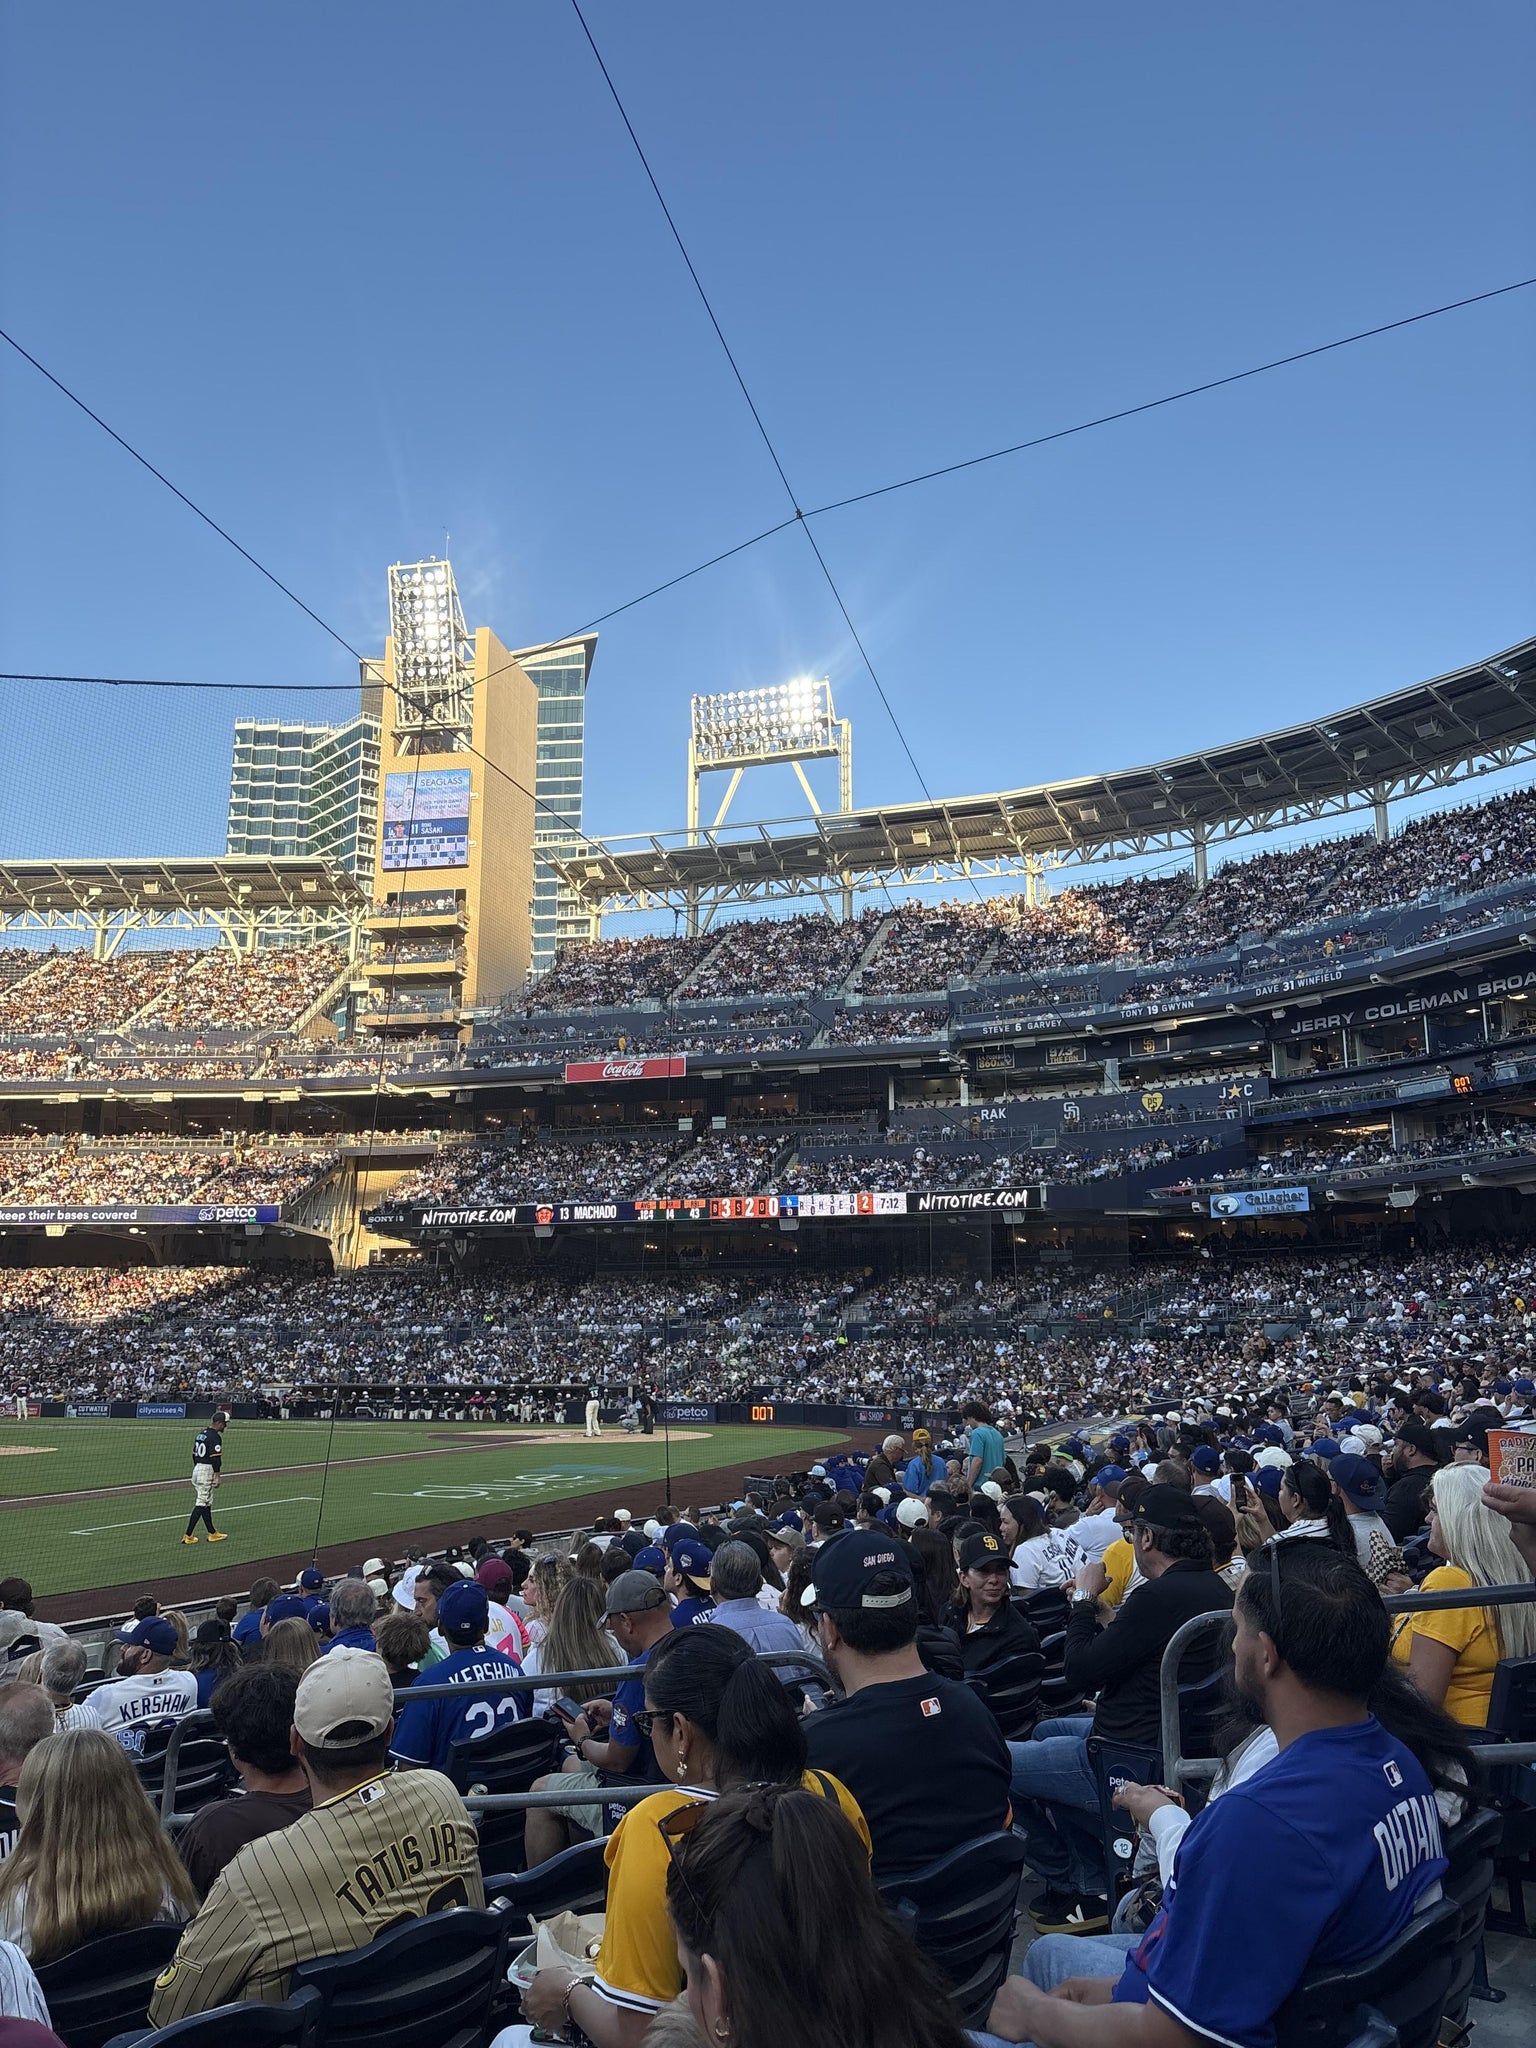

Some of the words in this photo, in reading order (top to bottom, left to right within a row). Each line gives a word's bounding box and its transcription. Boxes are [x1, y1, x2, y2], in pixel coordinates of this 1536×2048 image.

[420, 777, 463, 787] SEAGLASS
[1255, 984, 1280, 997] DAVE
[1282, 980, 1295, 992] 31
[1296, 971, 1343, 988] WINFIELD
[1120, 1007, 1144, 1019] TONY
[1147, 1004, 1159, 1016] 19
[1161, 999, 1195, 1012] GWYNN
[1290, 1011, 1355, 1034] JERRY
[1364, 987, 1469, 1020] COLEMAN
[982, 1025, 1010, 1035] STEVE
[1015, 1022, 1022, 1032] 6
[1027, 1019, 1062, 1030] GARVEY
[1243, 1083, 1253, 1096] C
[1147, 1097, 1158, 1109] PS
[980, 1107, 1007, 1120] RAK
[830, 1194, 835, 1204] 3
[849, 1194, 855, 1204] 0
[861, 1195, 870, 1209] 2
[880, 1197, 899, 1209] 7:12
[918, 1189, 1028, 1211] NITTOTIRE.COM
[1245, 1190, 1305, 1206] Gallagher
[721, 1198, 731, 1218] 3
[745, 1197, 755, 1218] 2
[768, 1197, 779, 1217] 0
[800, 1201, 805, 1211] R
[819, 1201, 824, 1210] H
[839, 1200, 844, 1210] E
[810, 1205, 816, 1215] 0
[830, 1205, 835, 1215] 0
[849, 1204, 855, 1214] 0
[0, 1210, 26, 1222] keep
[28, 1210, 55, 1221] their
[57, 1209, 89, 1220] bases
[91, 1209, 138, 1220] covered
[216, 1205, 257, 1221] petco
[367, 1215, 395, 1223] SONY
[421, 1207, 517, 1226] NITTOTIRE.COM
[559, 1207, 570, 1220] 13
[574, 1205, 618, 1220] MACHADO
[689, 1208, 700, 1219] 43
[590, 1390, 599, 1398] 13
[138, 1406, 177, 1415] citycruises
[676, 1406, 708, 1419] petco
[752, 1406, 773, 1421] 007
[868, 1411, 885, 1421] SHOP
[901, 1415, 914, 1423] petco
[903, 1421, 914, 1429] park
[372, 1473, 586, 1499] blue
[863, 1554, 876, 1568] SAN
[876, 1552, 895, 1564] DIEGO
[119, 1693, 191, 1723] KERSHAW
[608, 1802, 627, 1813] petco
[611, 1810, 624, 1820] par
[1119, 1842, 1129, 1855] 12
[335, 1834, 424, 1919] TATIS
[429, 1822, 466, 1869] JR.
